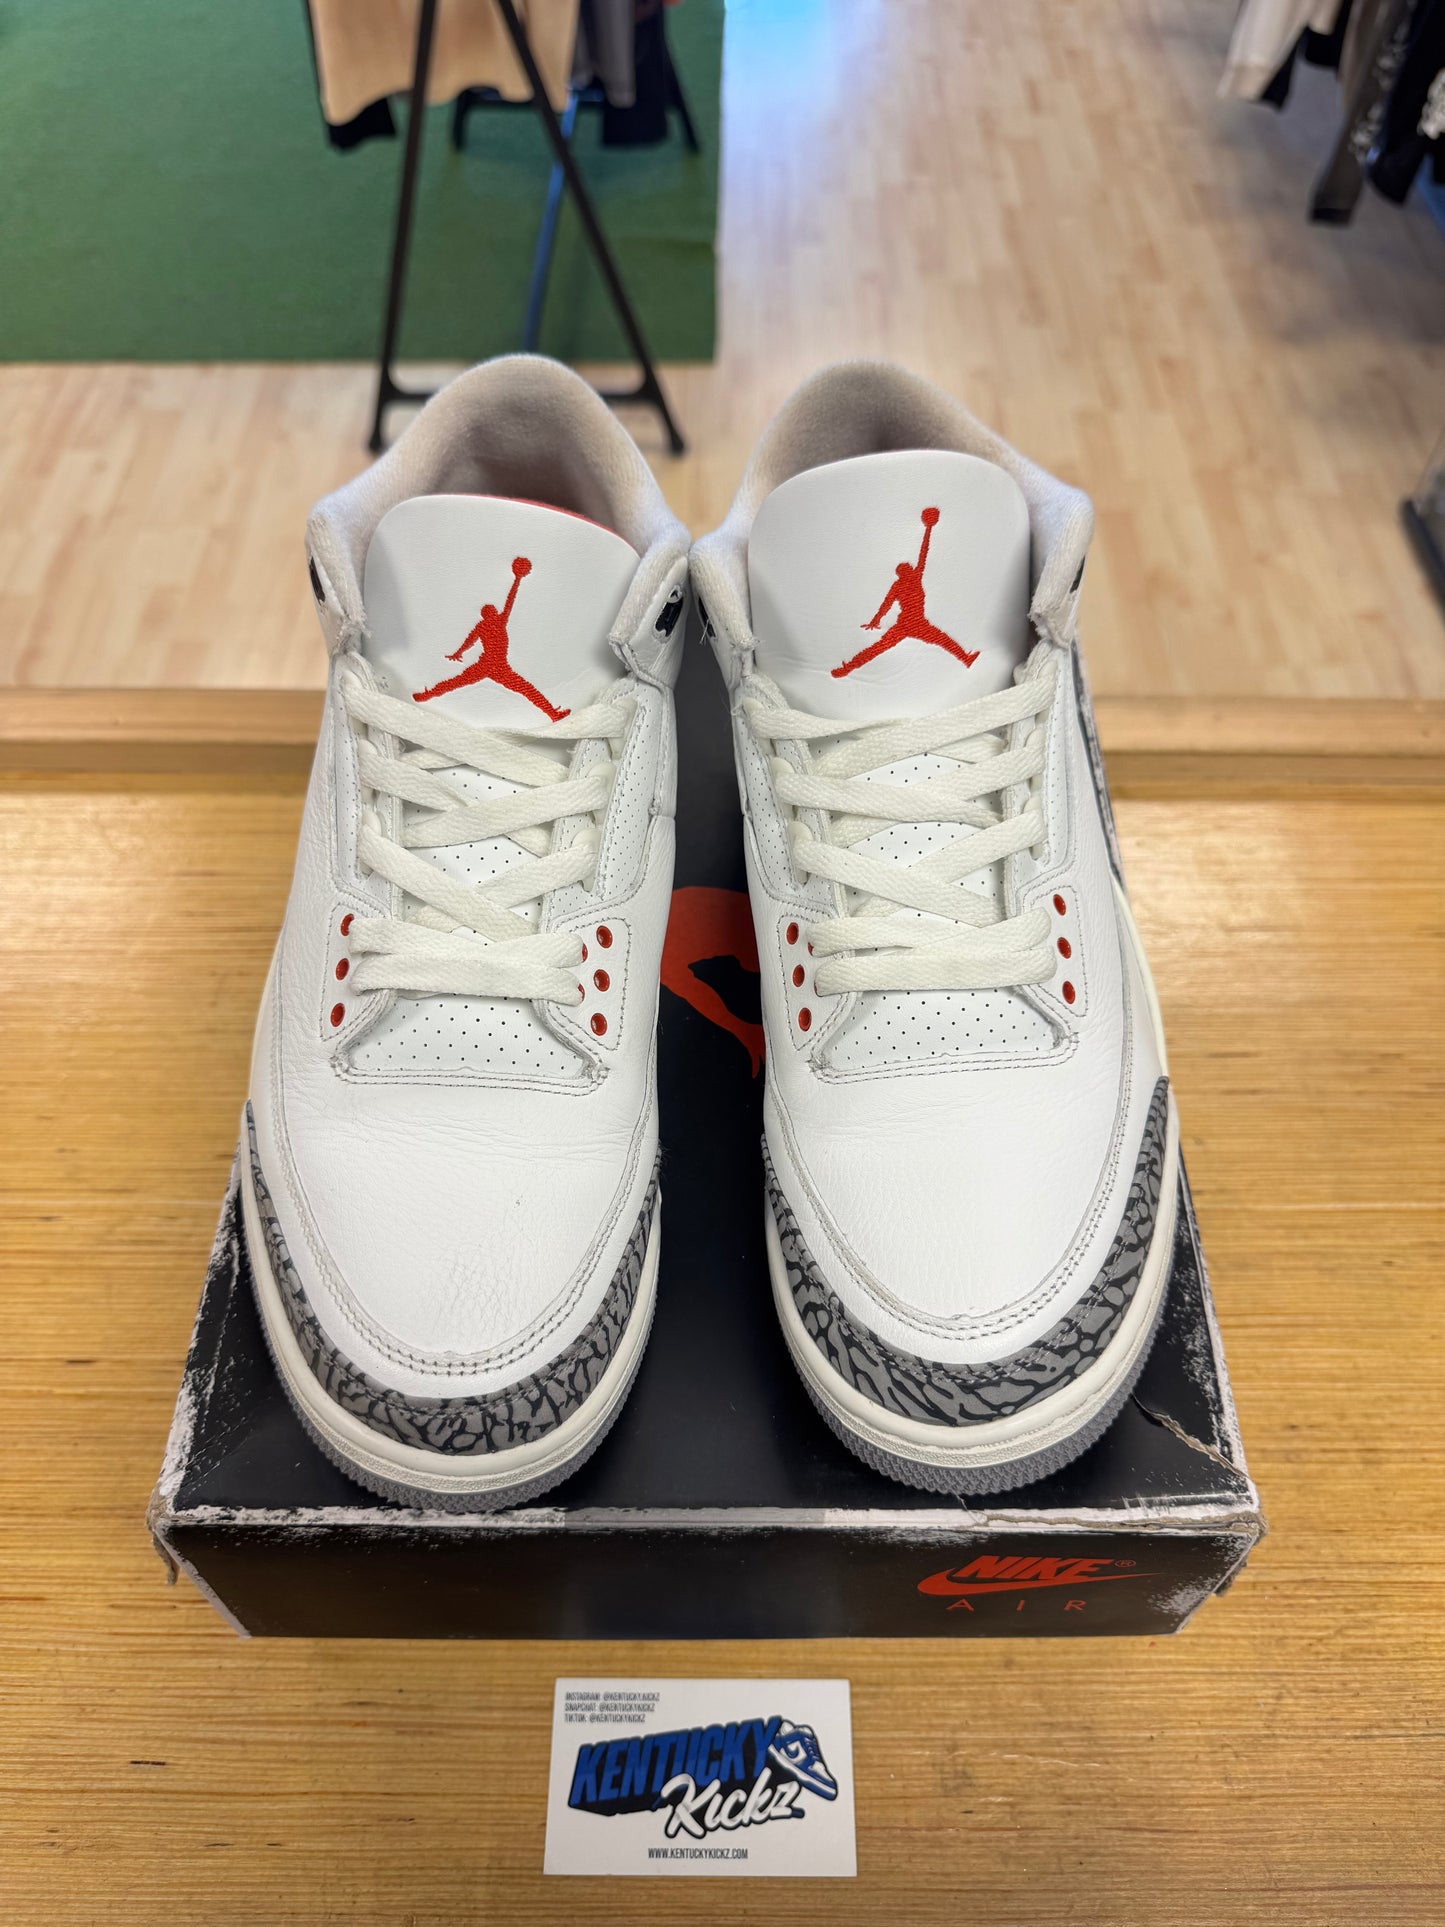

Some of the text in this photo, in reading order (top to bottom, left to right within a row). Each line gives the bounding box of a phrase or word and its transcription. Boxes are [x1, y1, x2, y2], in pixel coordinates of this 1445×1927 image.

[952, 1555, 1114, 1580] NIKE
[946, 1599, 1087, 1612] AIR
[569, 1716, 782, 1808] KENTUCKY
[659, 1766, 803, 1838] Kickz
[648, 1847, 748, 1860] WWW.KENTUCKYKICKZ.COM
